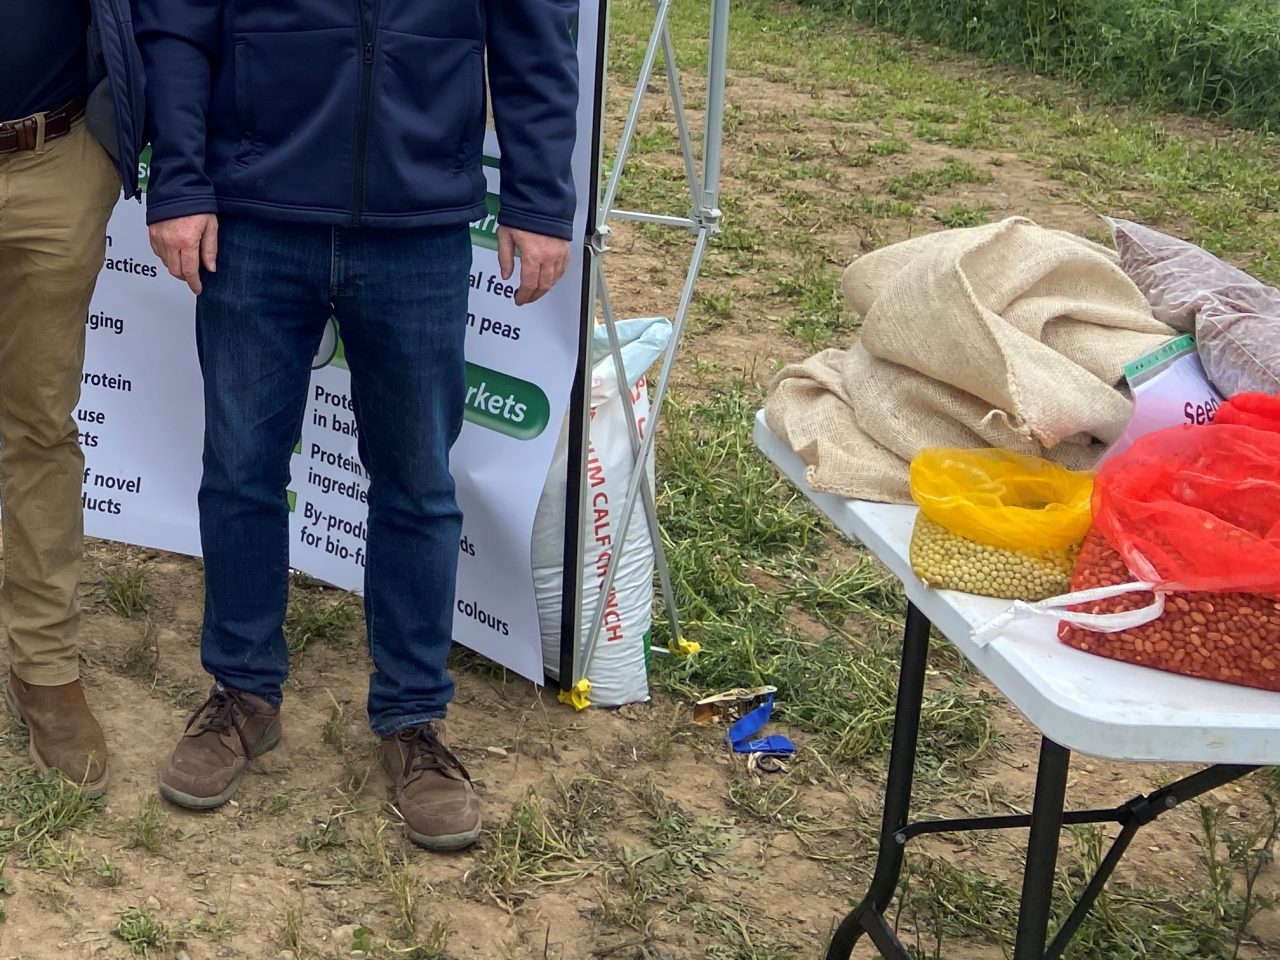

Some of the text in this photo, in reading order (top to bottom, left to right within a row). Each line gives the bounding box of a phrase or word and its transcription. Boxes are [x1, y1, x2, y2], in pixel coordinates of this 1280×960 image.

[105, 257, 157, 278] actices
[486, 274, 516, 299] fee
[478, 316, 521, 341] peas
[464, 382, 528, 423] rkets
[77, 408, 106, 425] use
[312, 408, 328, 428] in
[310, 442, 363, 477] Protein
[94, 474, 142, 494] novel
[592, 492, 612, 547] CALF
[300, 525, 322, 549] for
[457, 599, 509, 636] colours
